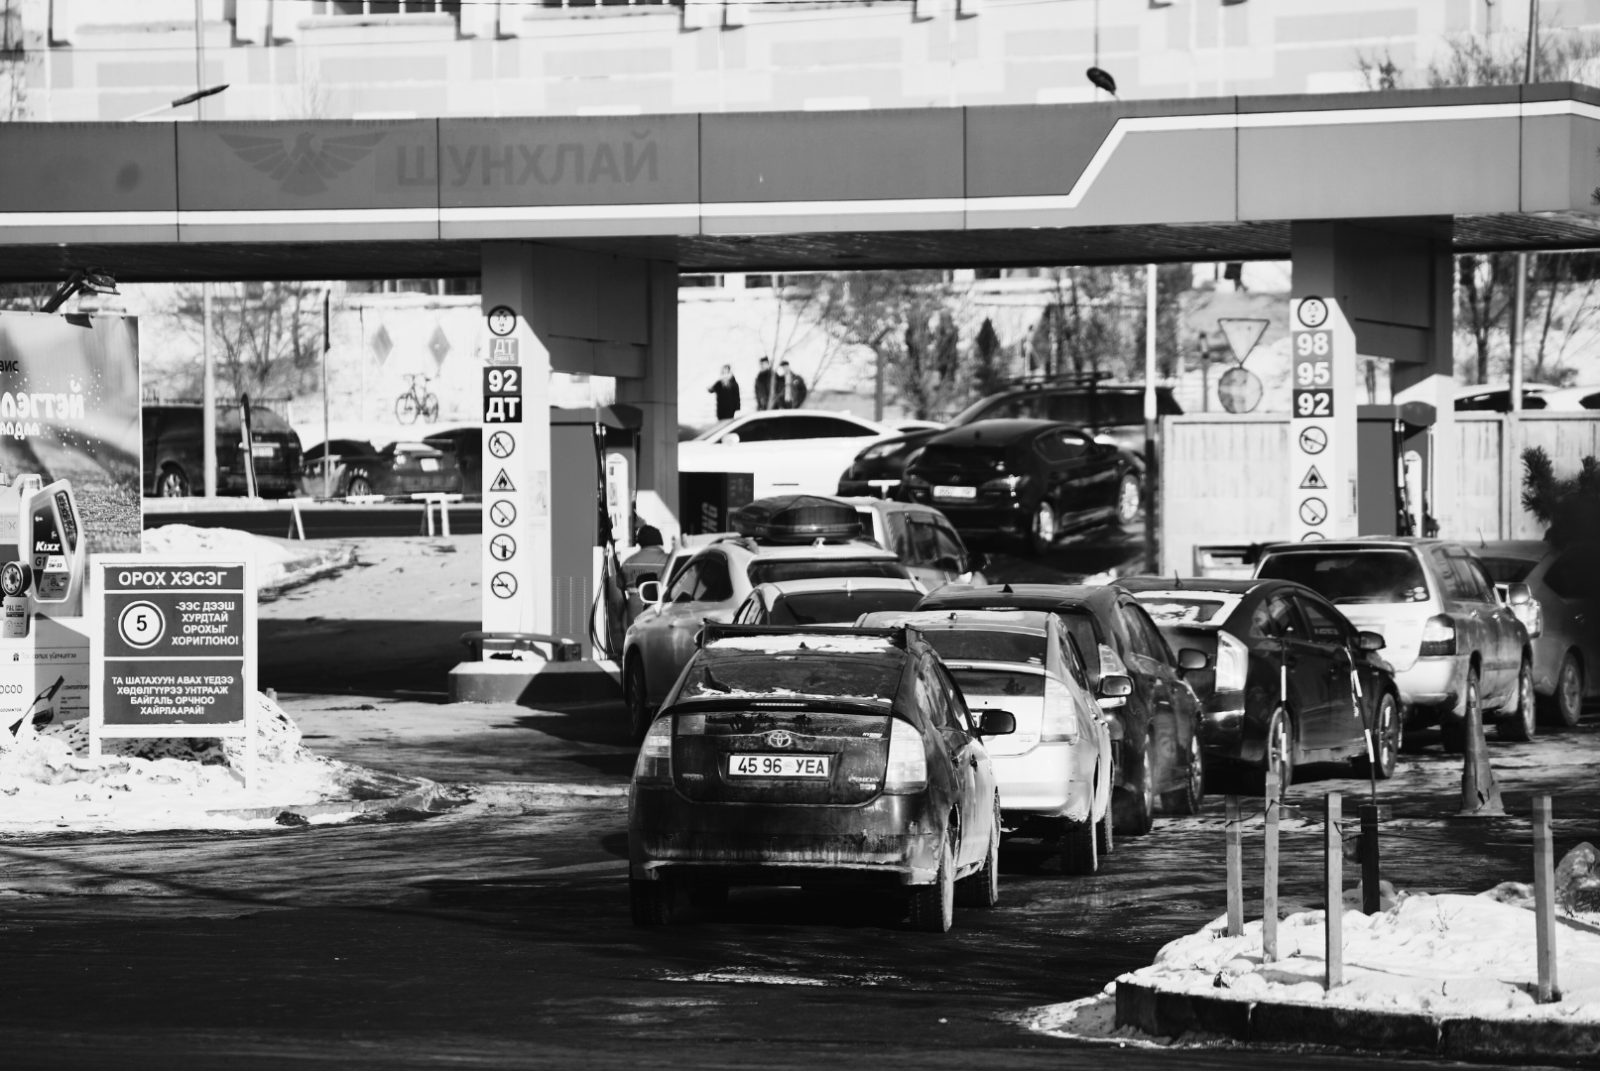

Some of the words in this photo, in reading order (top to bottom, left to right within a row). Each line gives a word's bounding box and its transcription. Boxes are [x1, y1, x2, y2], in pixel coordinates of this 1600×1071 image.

[397, 129, 659, 187] ШУНХЛАЙ
[493, 340, 515, 355] ДТ
[1297, 332, 1329, 356] 98
[488, 369, 518, 392] 92
[1297, 362, 1330, 386] 95
[486, 397, 520, 422] ДТ
[1297, 392, 1330, 416] 92
[35, 541, 60, 551] Kixx
[35, 556, 47, 567] G1
[118, 571, 167, 586] ОРОХ
[170, 571, 227, 586] ХЭСЭГ
[202, 601, 235, 612] ДЭЭШ
[136, 614, 148, 632] 5
[181, 611, 229, 623] ХУРДТАЙ
[183, 624, 228, 634] ОРОХЫГ
[171, 635, 239, 645] ХОРИГЛОНО!
[112, 676, 123, 685] ТА
[125, 676, 175, 685] ШАТАХУУН
[176, 676, 202, 684] АВАХ
[203, 676, 234, 685] ҮЕДЭЭ
[117, 686, 183, 695] ХӨДӨЛГҮҮРЭЭ
[185, 686, 229, 694] УНТРААЖ
[130, 696, 173, 705] БАЙГАЛЬ
[175, 696, 215, 704] ОРЧНОО
[140, 706, 205, 715] ХАЙРЛААРАЙ!
[738, 757, 758, 773] 45
[763, 758, 782, 773] 96
